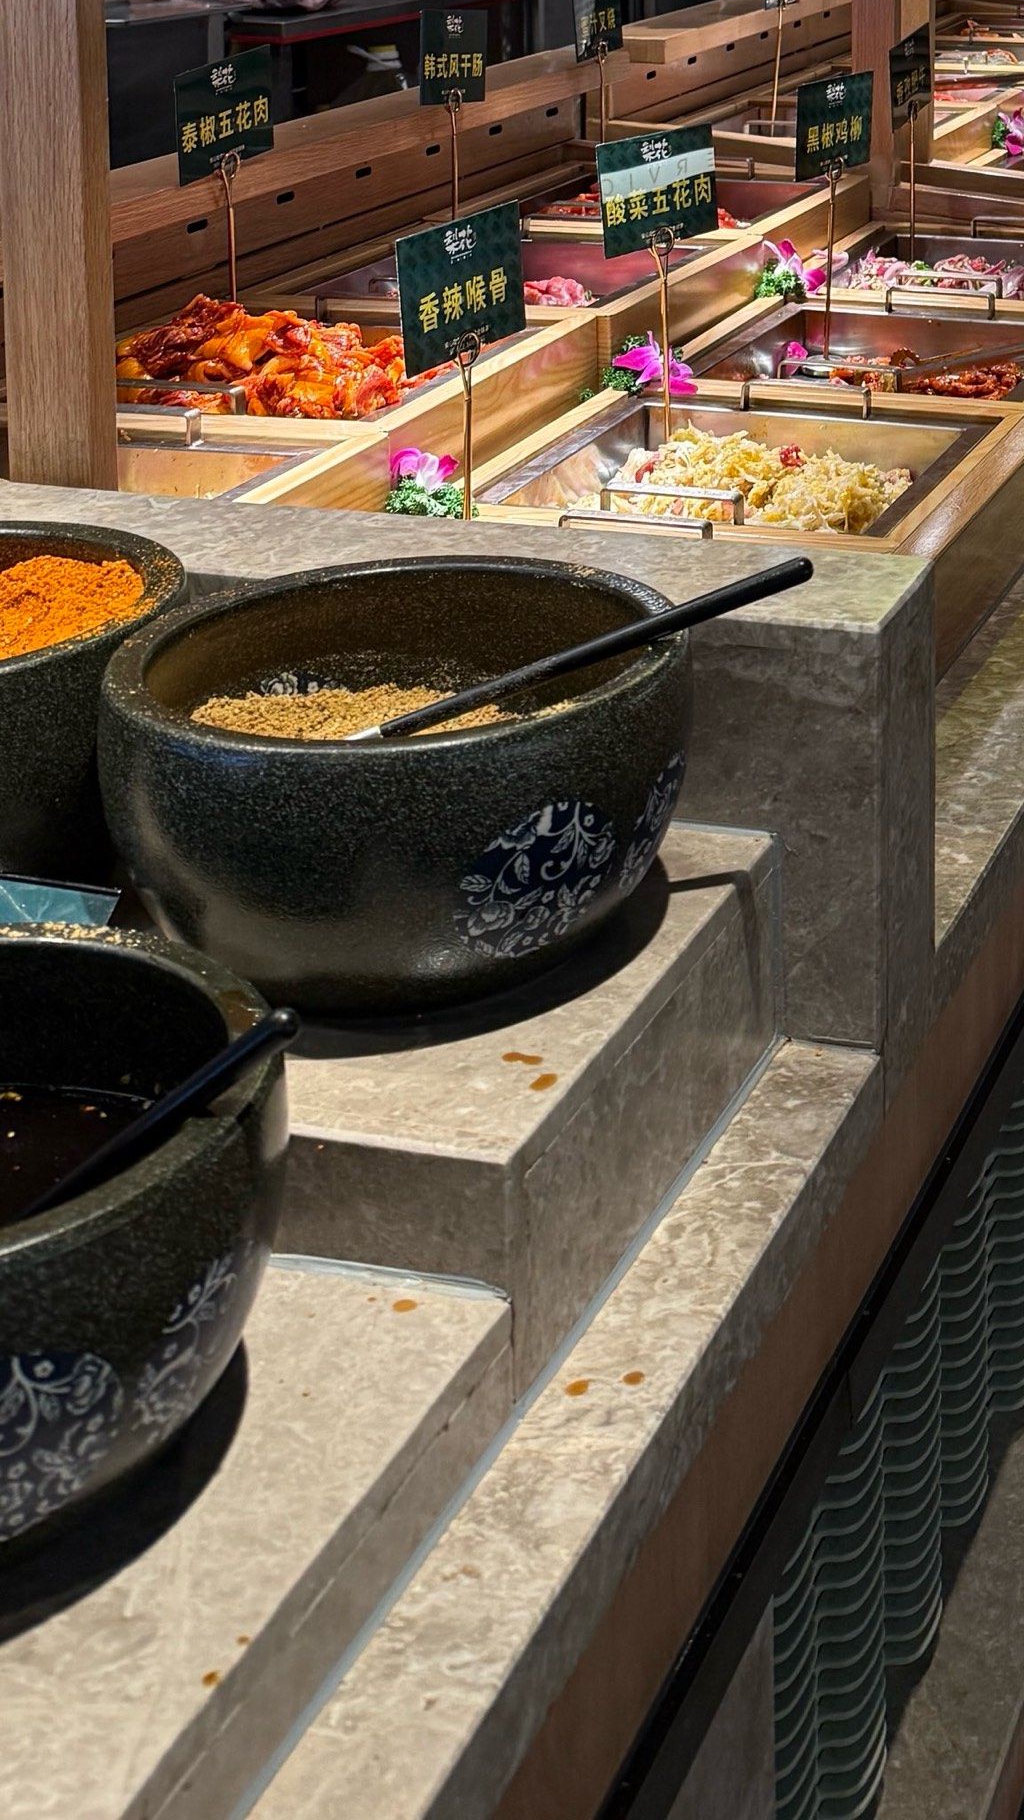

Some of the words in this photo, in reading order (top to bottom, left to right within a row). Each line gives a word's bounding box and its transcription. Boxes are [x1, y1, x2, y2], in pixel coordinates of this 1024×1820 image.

[424, 53, 483, 80] 韩式风干肠
[181, 94, 269, 154] 泰椒五花肉
[806, 115, 863, 154] 黑椒鸡柳
[605, 174, 712, 228] 酸菜五花肉
[418, 266, 507, 333] 香辣喉骨
